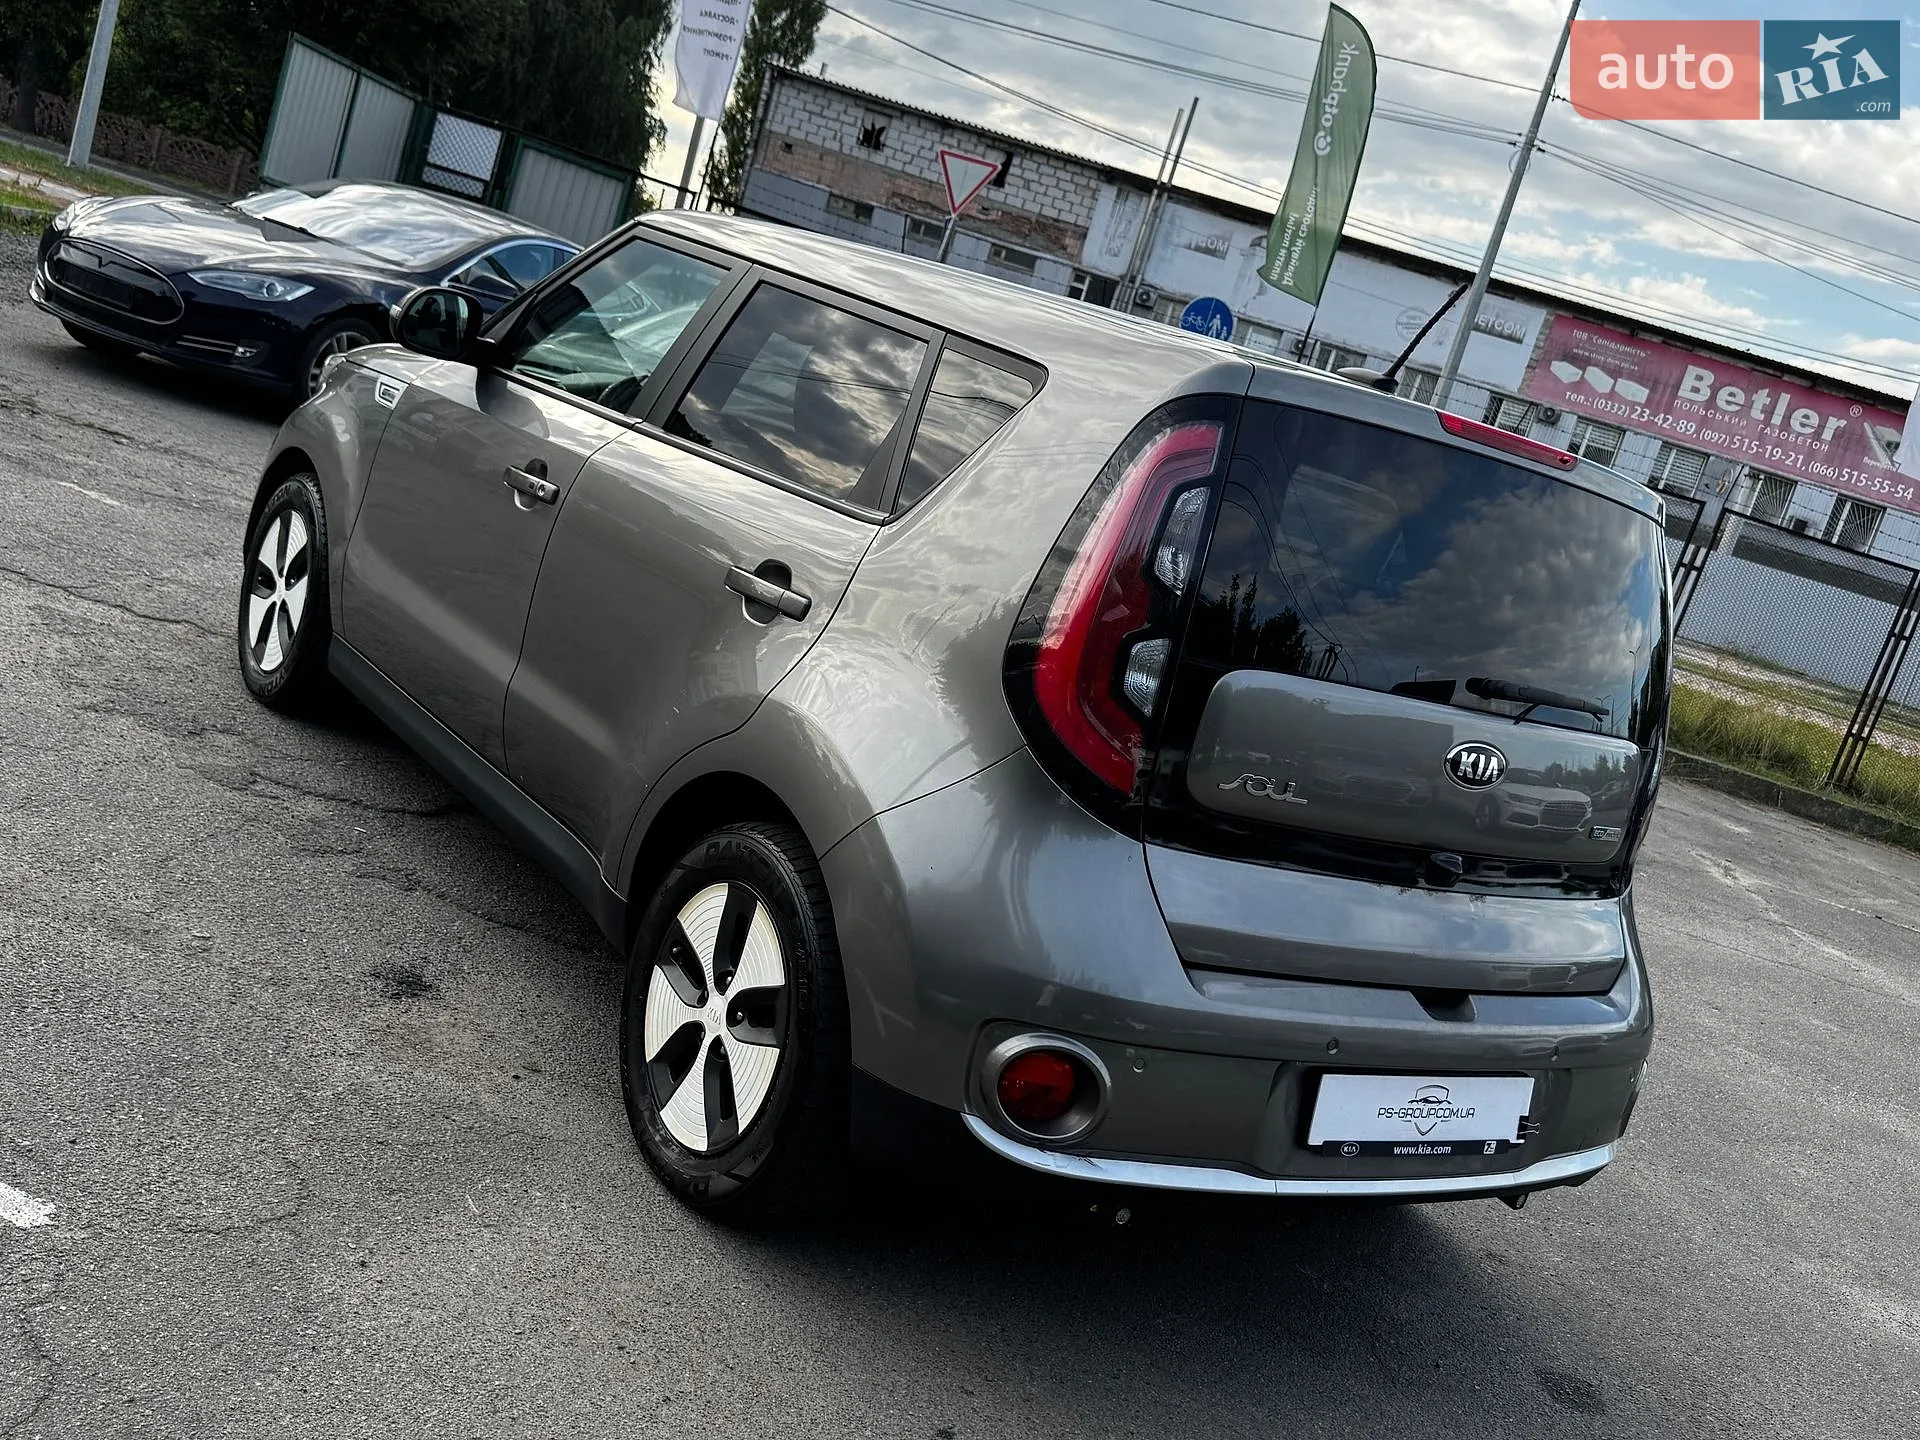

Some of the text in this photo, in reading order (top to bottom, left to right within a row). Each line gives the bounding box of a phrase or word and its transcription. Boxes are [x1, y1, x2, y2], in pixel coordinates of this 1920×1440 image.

[1673, 400, 1830, 453] ПОЛЬСЬКИЙ ГАЗОБЕТОН
[1677, 364, 1848, 442] Betler
[1565, 390, 1914, 501] тел.: (0332) 23-42-89, (097) 515-19-21, (066) 515-55-54
[1460, 751, 1503, 782] KIA
[1393, 1143, 1452, 1155] www.kia.com
